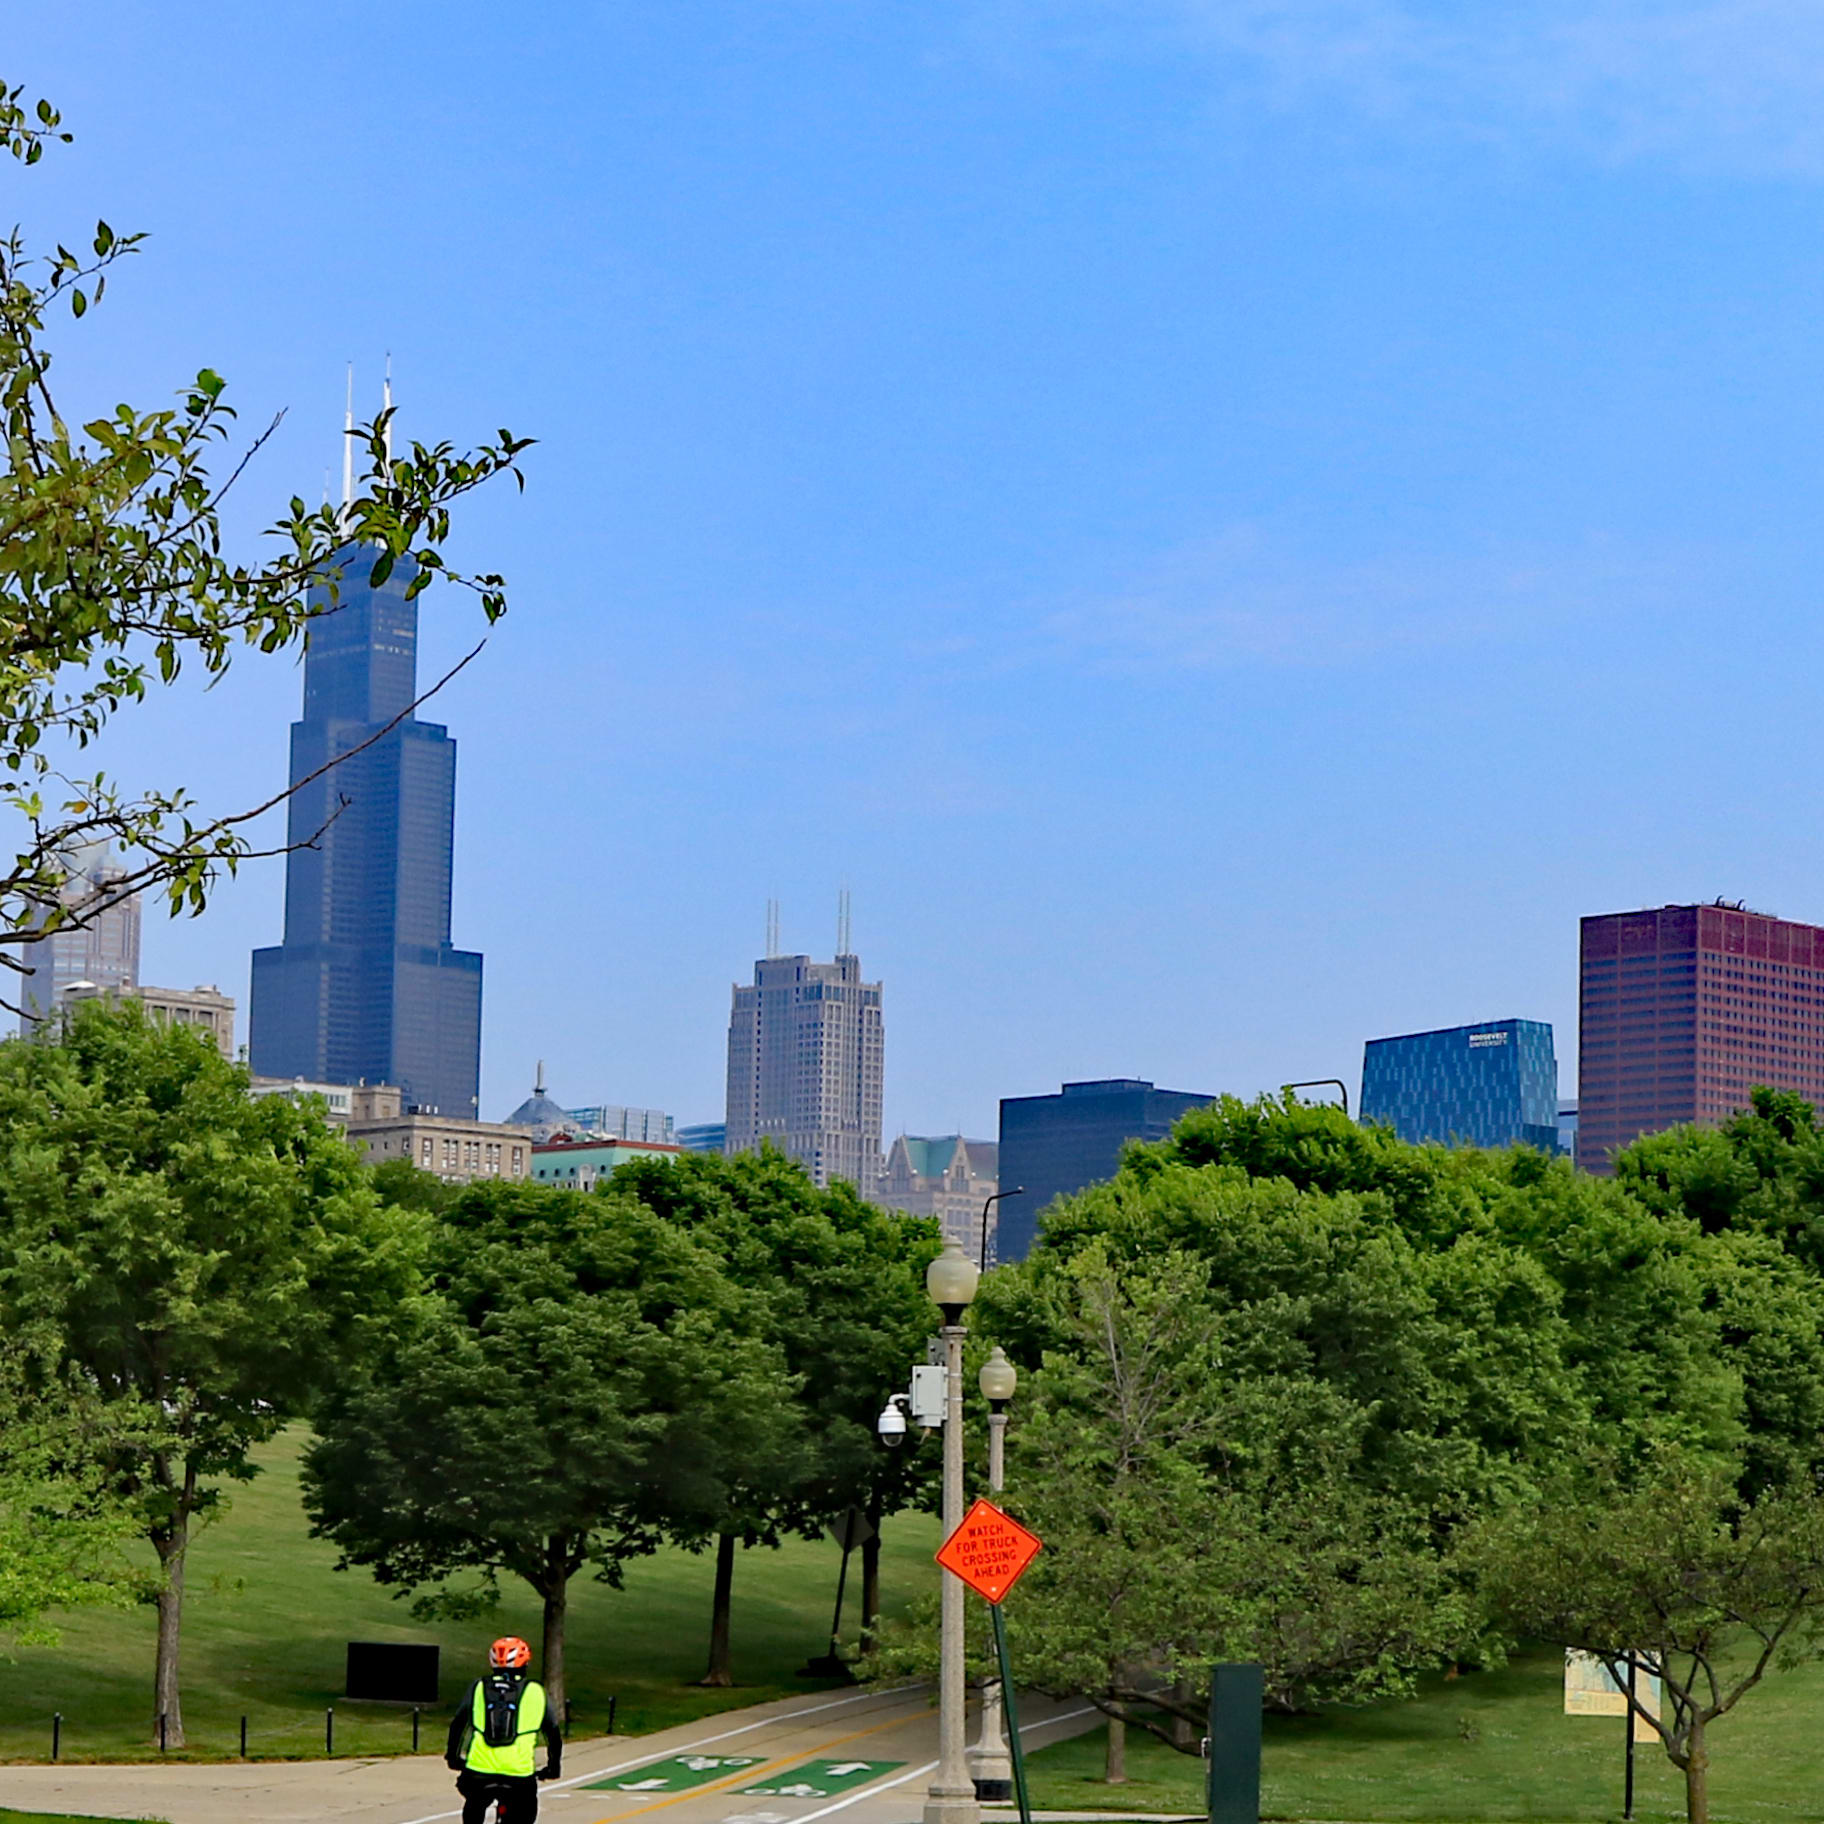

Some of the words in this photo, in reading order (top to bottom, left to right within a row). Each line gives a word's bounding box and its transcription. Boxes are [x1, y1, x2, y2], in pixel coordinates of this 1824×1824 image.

[968, 1524, 1004, 1538] WATCH
[956, 1541, 978, 1554] FOR
[983, 1536, 1018, 1551] TRUCK
[962, 1549, 1017, 1567] CROSSING
[974, 1564, 1010, 1578] AHEAD
